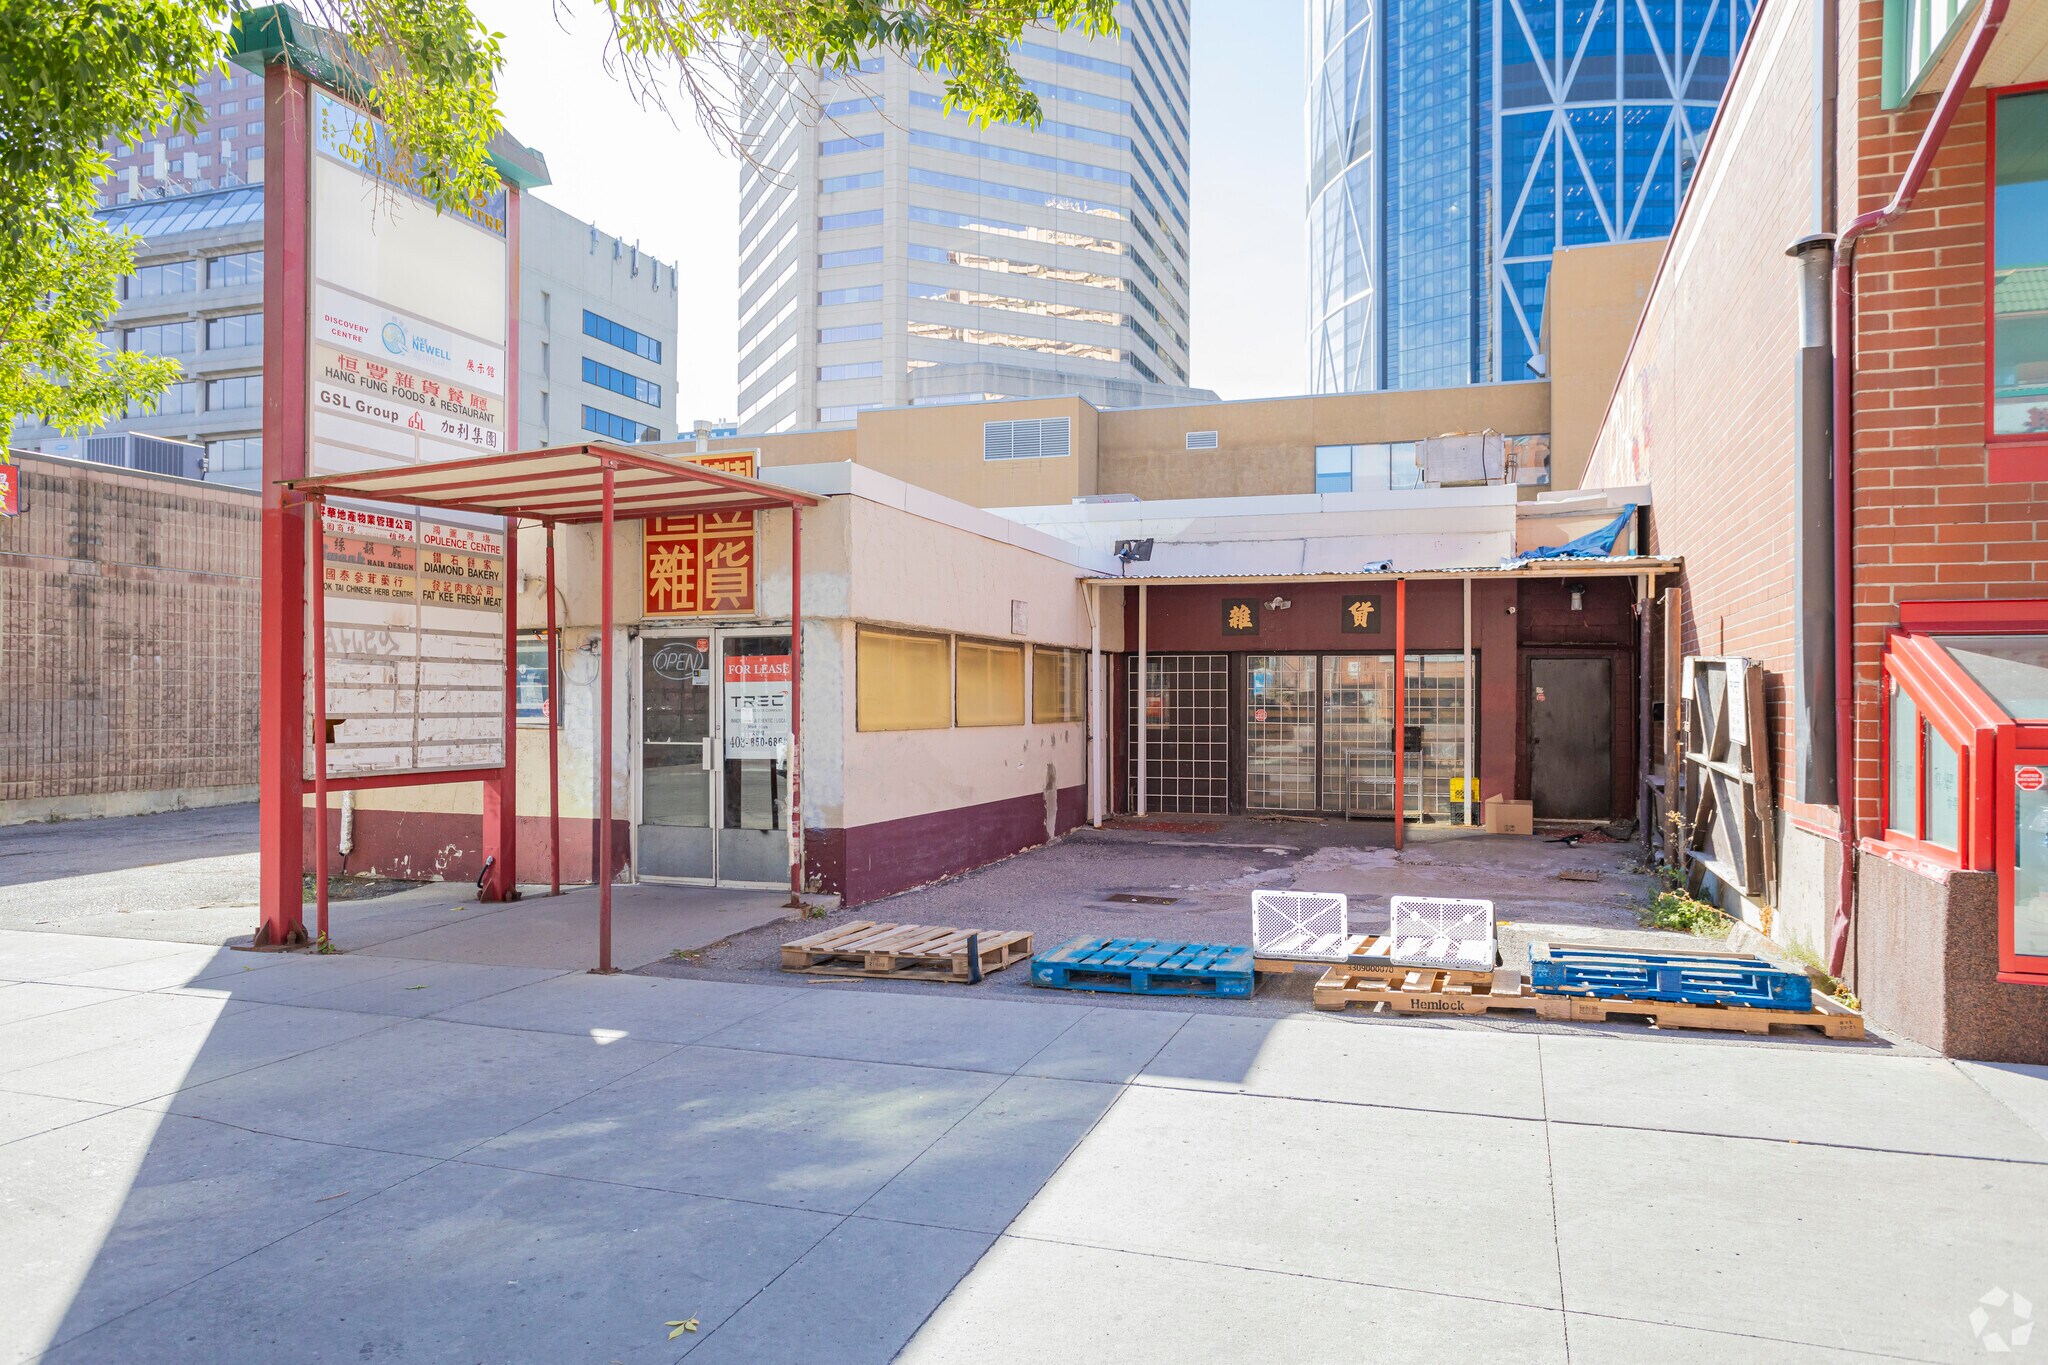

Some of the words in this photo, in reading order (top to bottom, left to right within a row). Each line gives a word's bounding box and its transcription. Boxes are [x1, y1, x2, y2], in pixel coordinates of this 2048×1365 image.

[324, 315, 369, 334] DISCOVERY
[331, 328, 363, 343] CENTRE
[412, 341, 451, 360] NEWELL
[467, 359, 495, 378] 展示馆
[325, 366, 356, 384] HANG
[360, 376, 388, 393] FUNG
[392, 385, 425, 404] FOODS
[429, 396, 436, 407] &
[440, 400, 495, 423] RESTAURANT
[320, 390, 351, 409] GSL
[355, 400, 399, 422] Group
[408, 411, 426, 431] GSL
[441, 420, 497, 448] 加利集團
[424, 534, 467, 549] OPULENCE
[470, 542, 501, 554] CENTRE
[367, 559, 385, 568] HAIR
[388, 562, 414, 571] DESIGN
[424, 562, 464, 576] DIAMOND
[468, 568, 500, 580] BAKERY
[650, 540, 750, 610] 雜貨
[335, 583, 344, 592] TAI
[346, 585, 372, 595] CHINESE
[374, 587, 390, 596] HERB
[392, 589, 414, 598] CENTRE
[422, 590, 436, 600] FAT
[439, 592, 454, 602] KEE
[457, 594, 481, 605] FRESH
[484, 596, 502, 607] MEAT
[1347, 601, 1375, 628] 貨
[656, 653, 699, 670] OPEN
[728, 664, 751, 675] FOR
[754, 663, 790, 674] LEASE
[730, 695, 784, 707] TREC
[1410, 998, 1465, 1011] Hemlock
